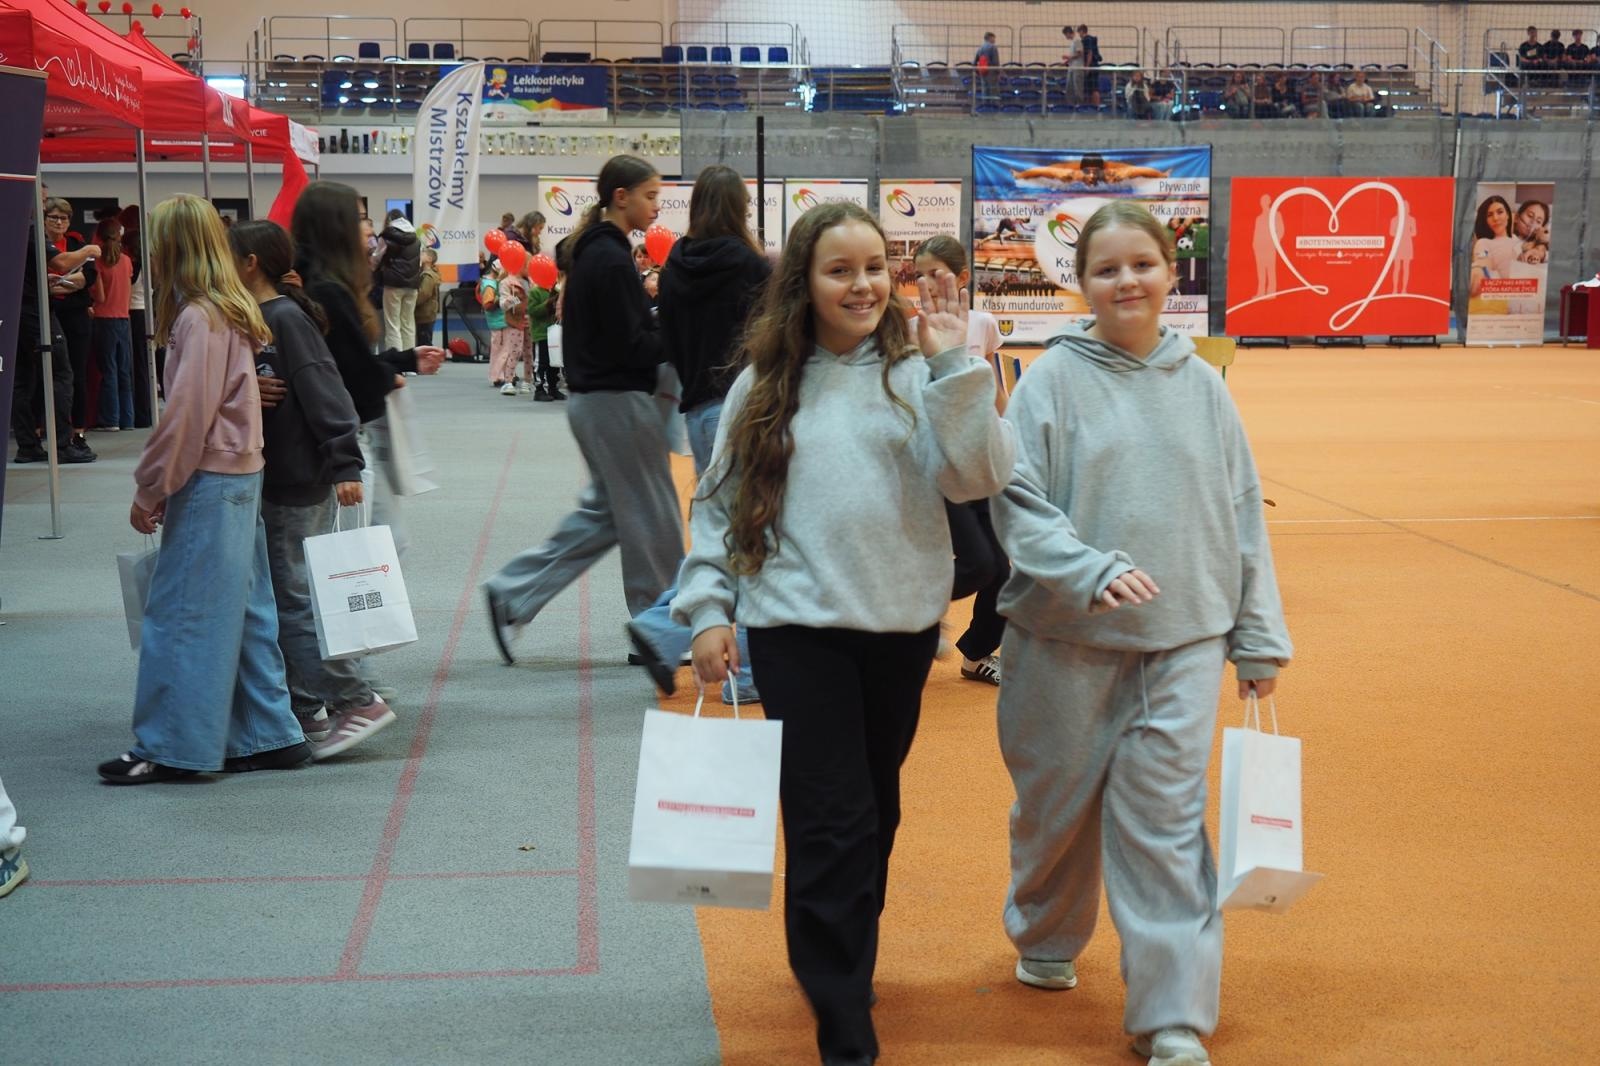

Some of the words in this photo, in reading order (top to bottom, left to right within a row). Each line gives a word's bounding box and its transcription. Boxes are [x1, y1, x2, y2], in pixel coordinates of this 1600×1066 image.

[513, 75, 585, 87] Lekkoatletyka
[250, 129, 268, 137] YCIE
[447, 92, 473, 210] Kształcimy
[428, 107, 448, 210] Mistrzów
[1159, 181, 1201, 195] Pływanie
[574, 194, 601, 206] ZSOM
[660, 199, 690, 209] ZSOM
[918, 196, 955, 207] ZSOMS
[981, 204, 1045, 217] Lekkoatletyka
[1149, 204, 1172, 216] Piłka
[1173, 204, 1201, 216] nożna
[442, 230, 476, 240] ZSOMS
[982, 299, 1006, 312] Klasy
[1008, 299, 1064, 311] mundurowe
[1167, 298, 1199, 312] Zapasy
